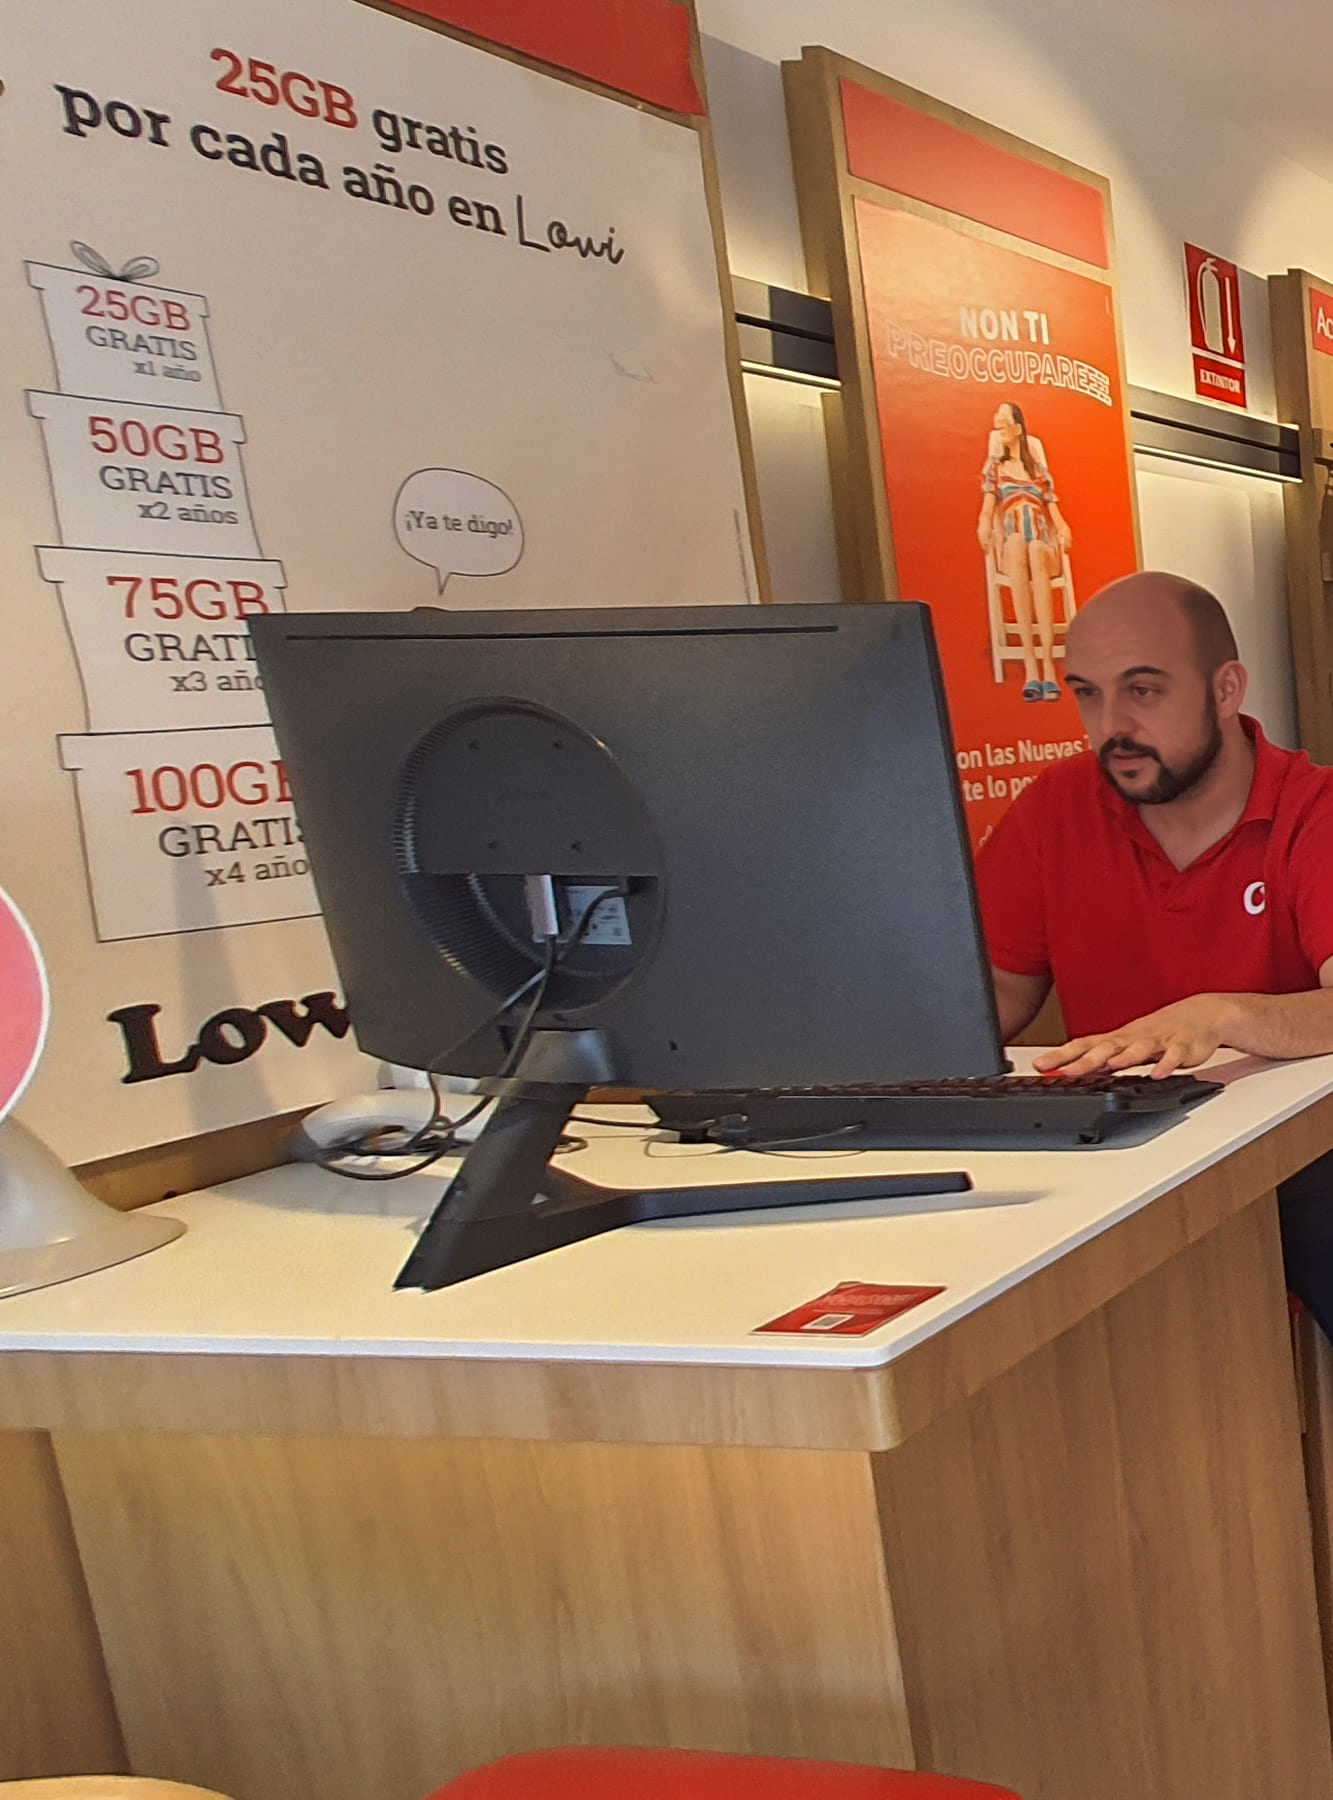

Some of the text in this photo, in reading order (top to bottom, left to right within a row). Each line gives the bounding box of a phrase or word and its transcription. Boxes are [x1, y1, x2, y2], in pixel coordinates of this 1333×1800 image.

[209, 48, 510, 176] 25GB gratis
[53, 83, 625, 265] por cada año en Lowi
[76, 285, 191, 331] 25GB
[959, 305, 1050, 345] NON TI
[85, 325, 198, 361] GRATIS
[133, 361, 158, 376] x1
[1200, 368, 1241, 394] EXTINTOR
[88, 416, 225, 464] 50GB
[99, 465, 233, 499] GRATIS
[137, 501, 239, 525] x2 años
[404, 510, 439, 532] ¡Ya
[443, 514, 463, 531] te
[106, 576, 272, 621] 75GB
[124, 633, 258, 662] GRATI
[169, 669, 265, 692] x3 año
[956, 738, 1085, 770] on las Nuevas
[962, 780, 985, 802] te
[987, 775, 1008, 799] lo
[205, 855, 311, 887] x4 año
